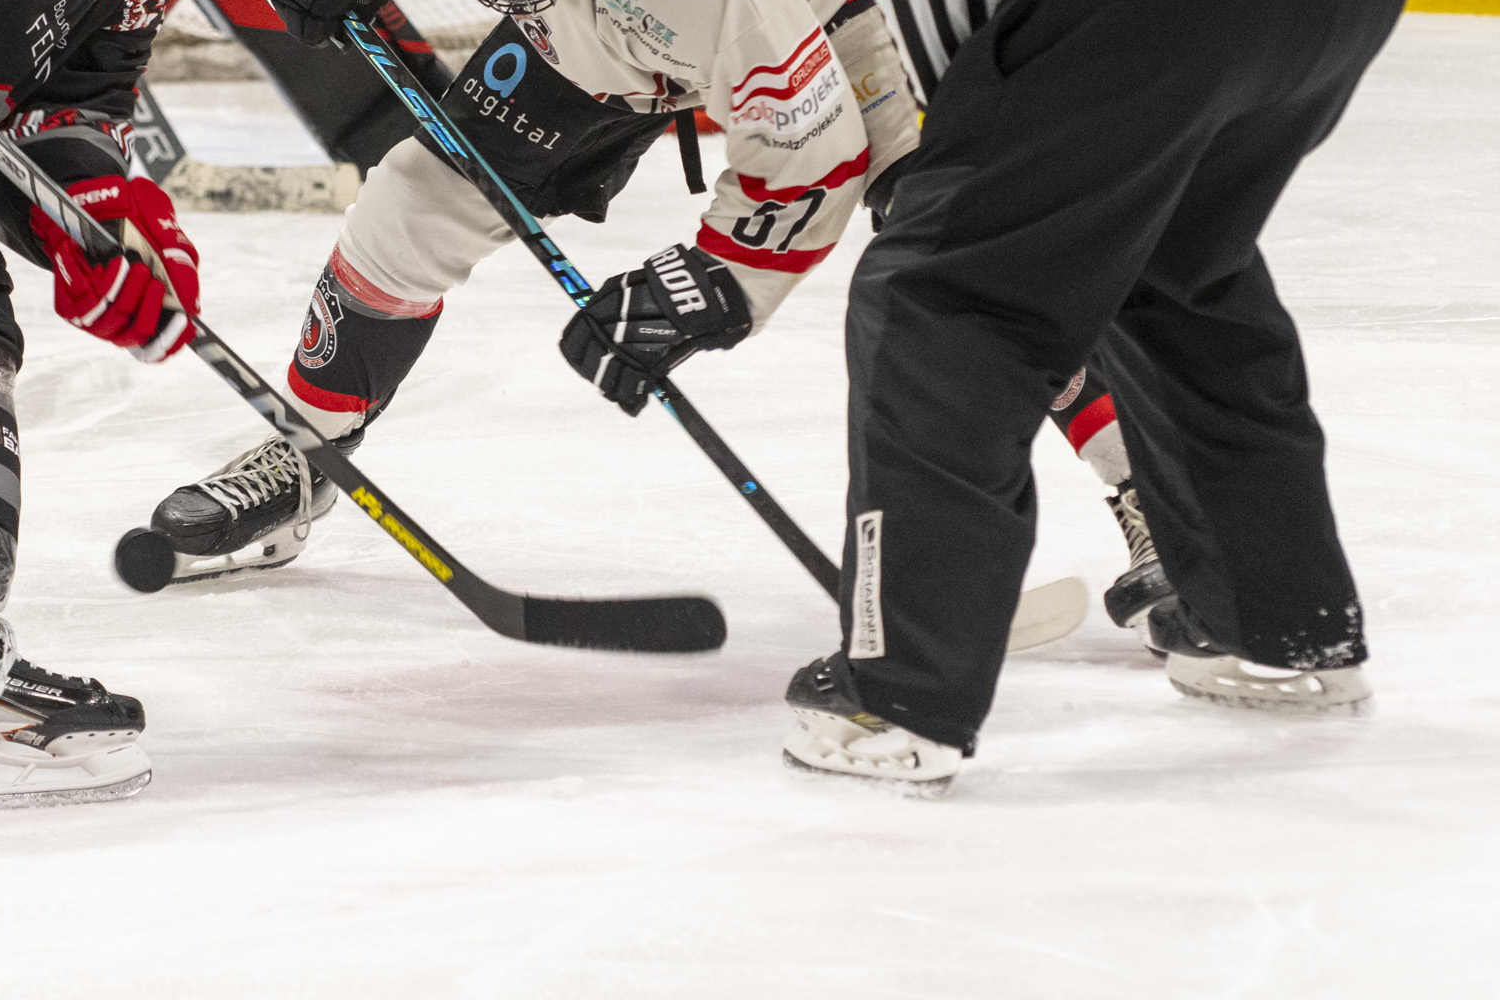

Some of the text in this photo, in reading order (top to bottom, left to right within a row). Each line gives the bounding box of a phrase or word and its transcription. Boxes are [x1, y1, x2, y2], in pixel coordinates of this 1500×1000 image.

[343, 10, 469, 159] ULSE
[463, 77, 562, 150] digital
[196, 322, 324, 451] CM
